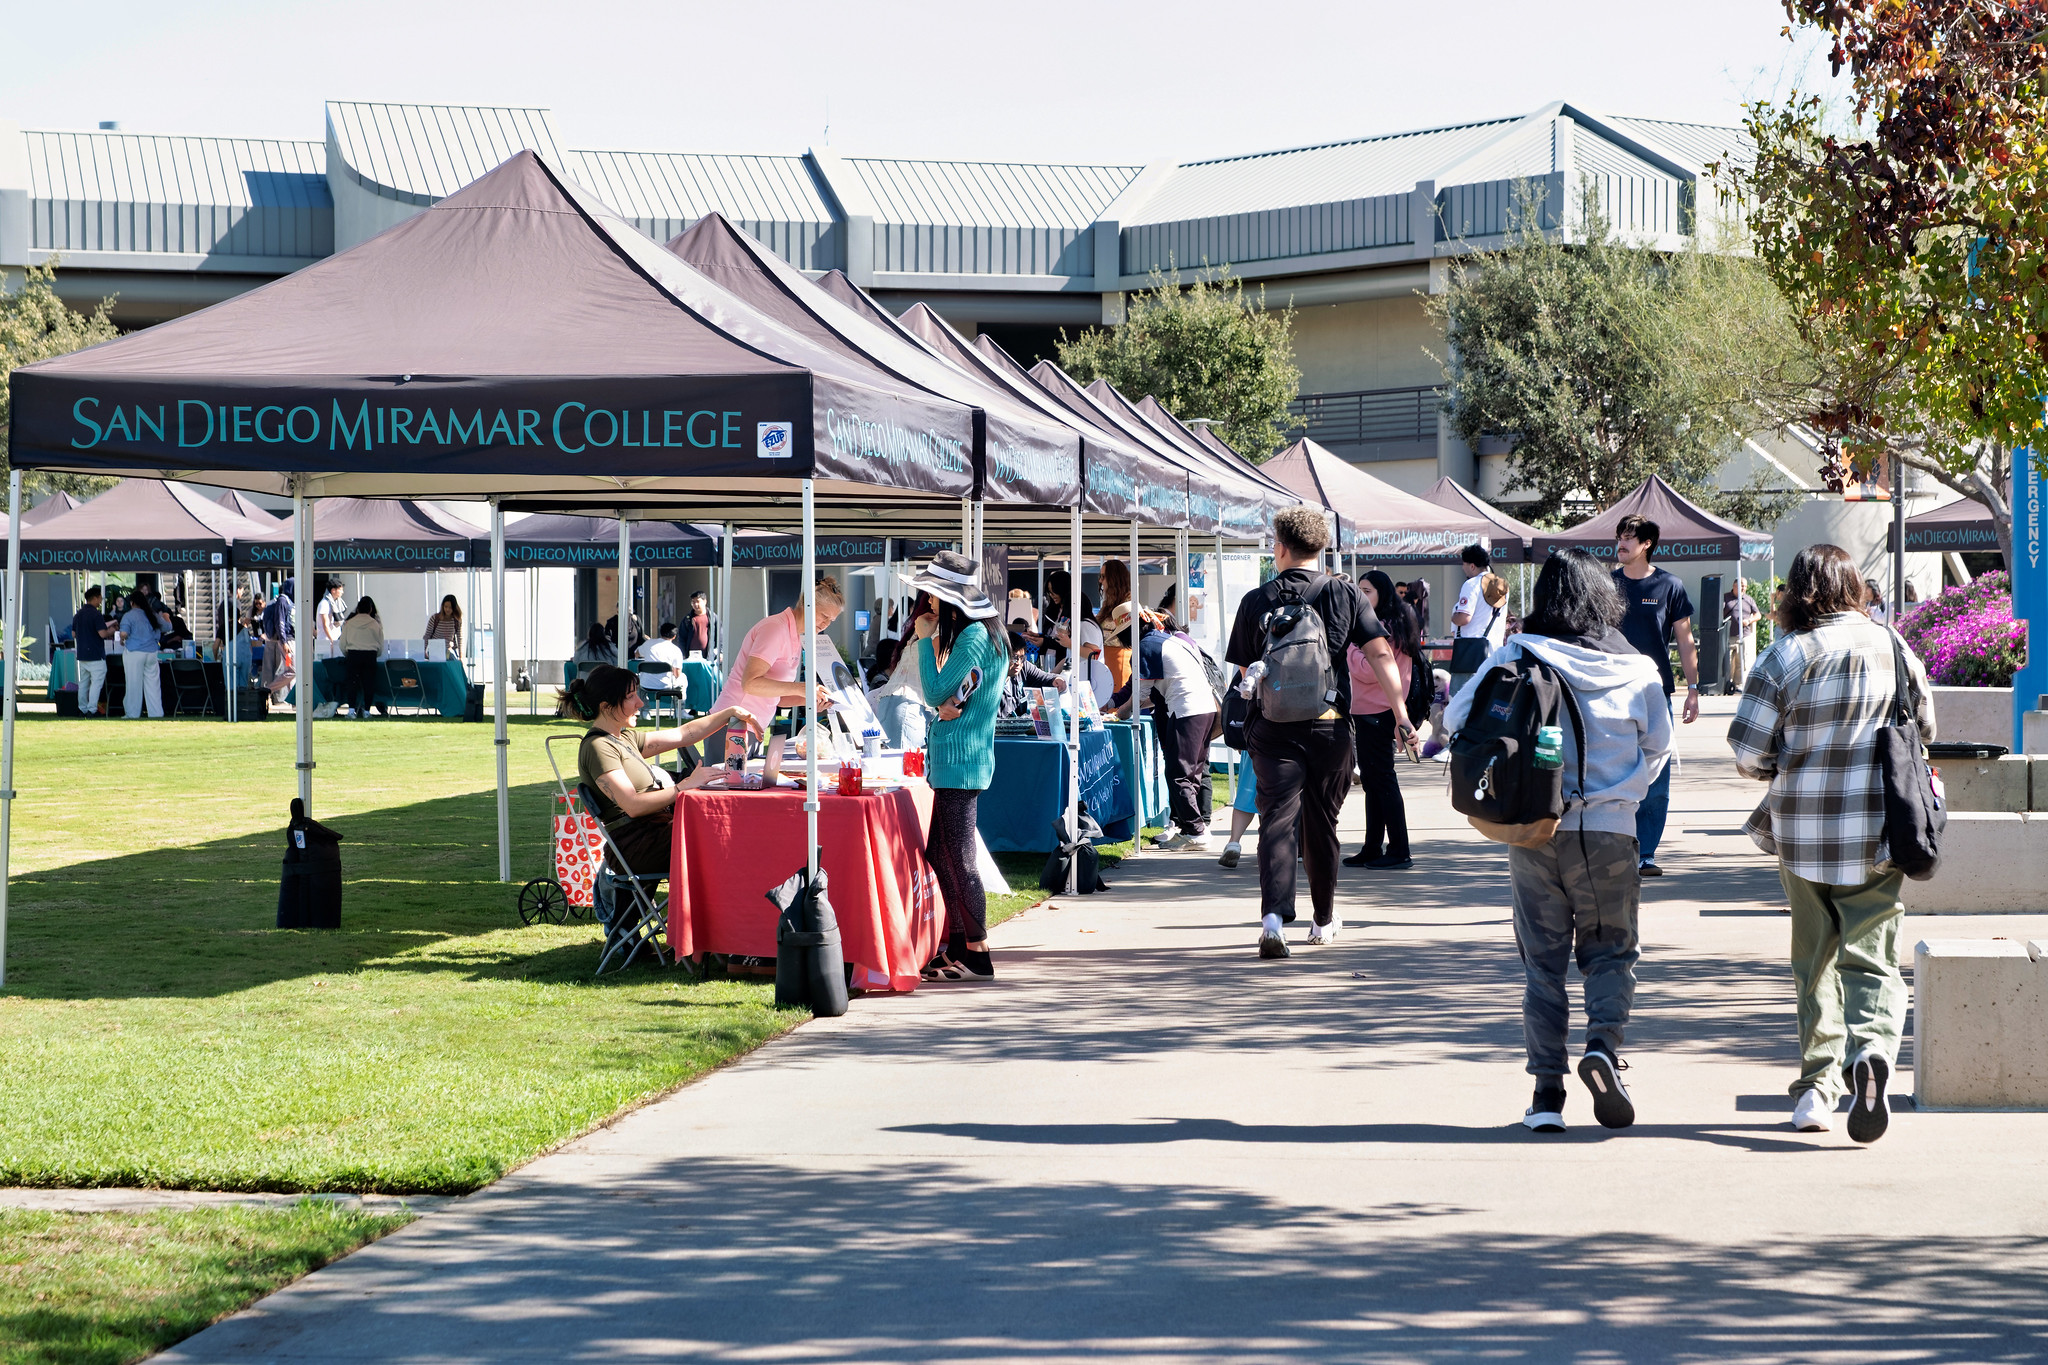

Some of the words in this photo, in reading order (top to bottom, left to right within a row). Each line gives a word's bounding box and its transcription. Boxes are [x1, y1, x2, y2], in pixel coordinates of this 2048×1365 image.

[70, 396, 165, 449] SAN
[177, 399, 321, 448] DIEGO
[329, 397, 544, 451] MIRAMAR
[552, 401, 742, 454] COLLEGE
[827, 408, 852, 460] SAN
[1372, 529, 1400, 547] DIEGO
[1924, 529, 1957, 546] DIEGO
[1958, 528, 1998, 546] MIRAM
[20, 551, 39, 563] AN
[41, 549, 84, 565] DIEGO
[85, 548, 149, 565] MIRAMAR
[150, 547, 206, 565] COLLEGE
[250, 546, 280, 562] SAN
[329, 545, 392, 562] MIRAMAR
[394, 545, 450, 562] COLLEGE
[521, 545, 566, 562] DIEGO
[634, 545, 693, 562] COLLEGE
[732, 544, 754, 562] SAN
[755, 544, 789, 561] DIEGO
[789, 542, 838, 560] MIMAR
[839, 540, 883, 558] COLLEGE
[1671, 542, 1722, 558] COLLEGE
